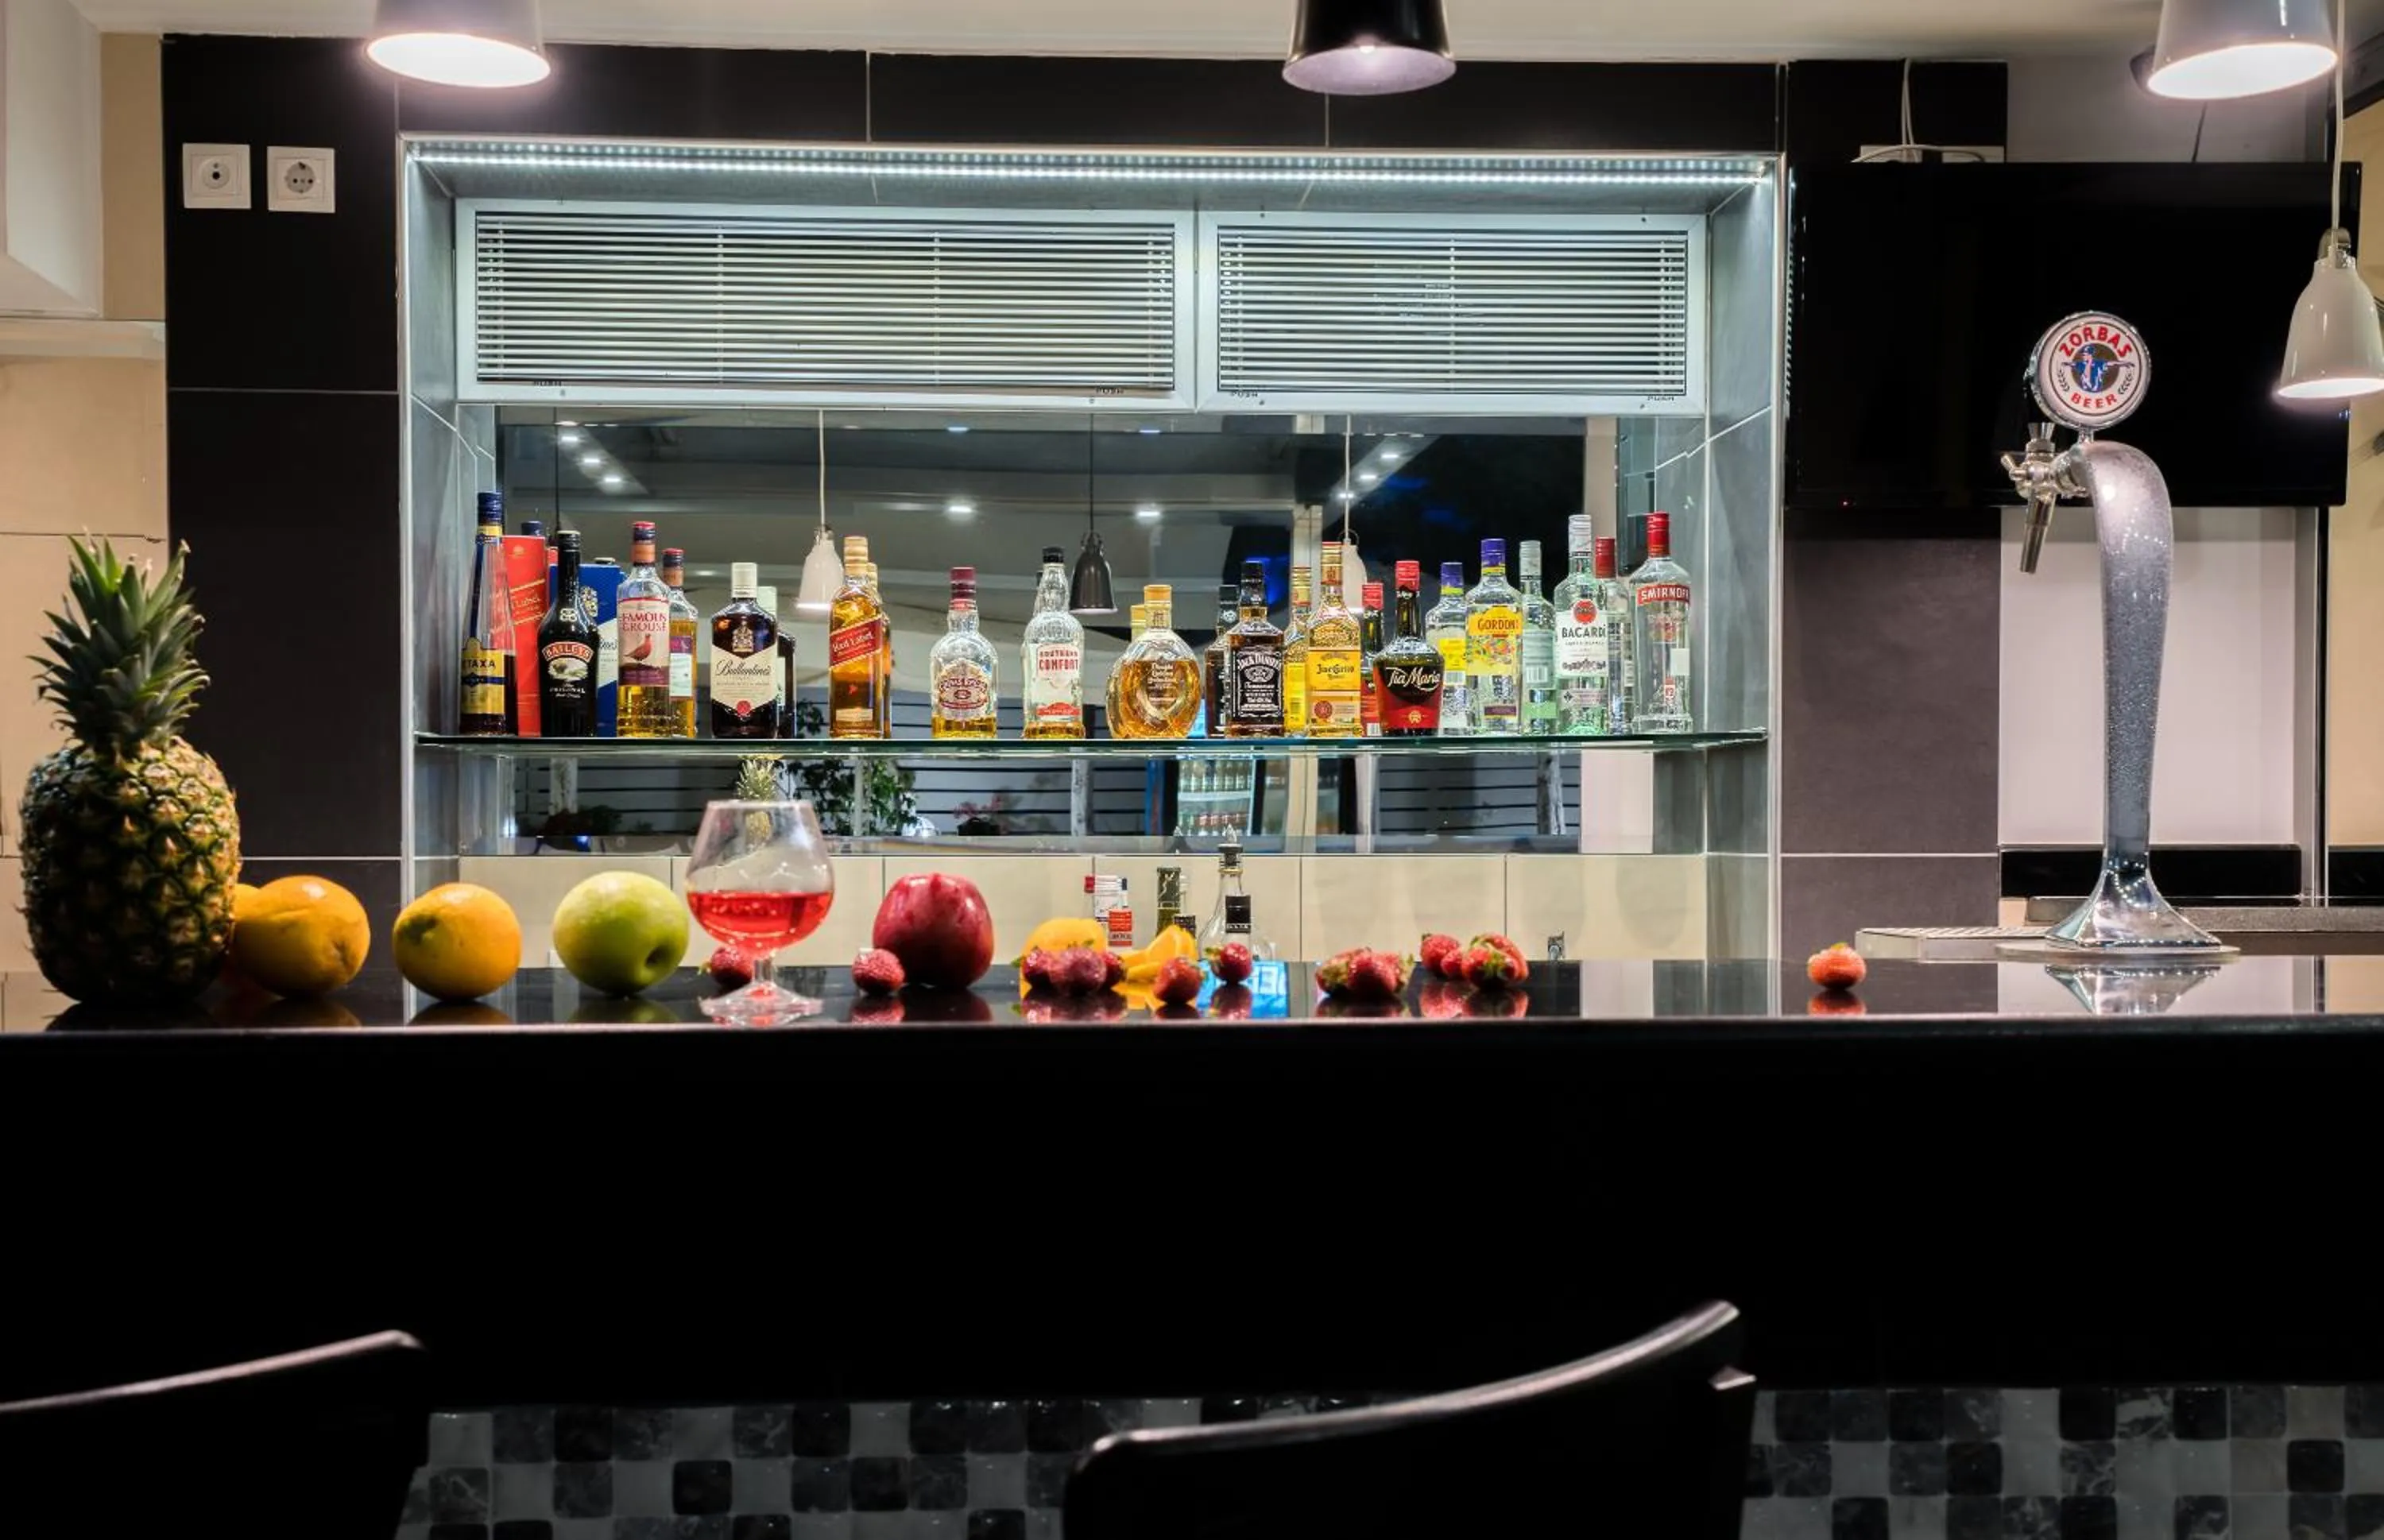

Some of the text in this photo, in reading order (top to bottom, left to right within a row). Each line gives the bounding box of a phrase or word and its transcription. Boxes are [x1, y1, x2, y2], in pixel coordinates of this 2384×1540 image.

[2059, 326, 2133, 358] ZORBAS
[2070, 393, 2117, 409] BEER
[622, 612, 667, 622] FAMOUS
[622, 622, 667, 633] GROUSE
[545, 644, 590, 658] BAILEYS
[715, 659, 772, 676] Ballantine's
[1039, 659, 1078, 671] COMFORT
[1385, 667, 1441, 691] Tia Maria
